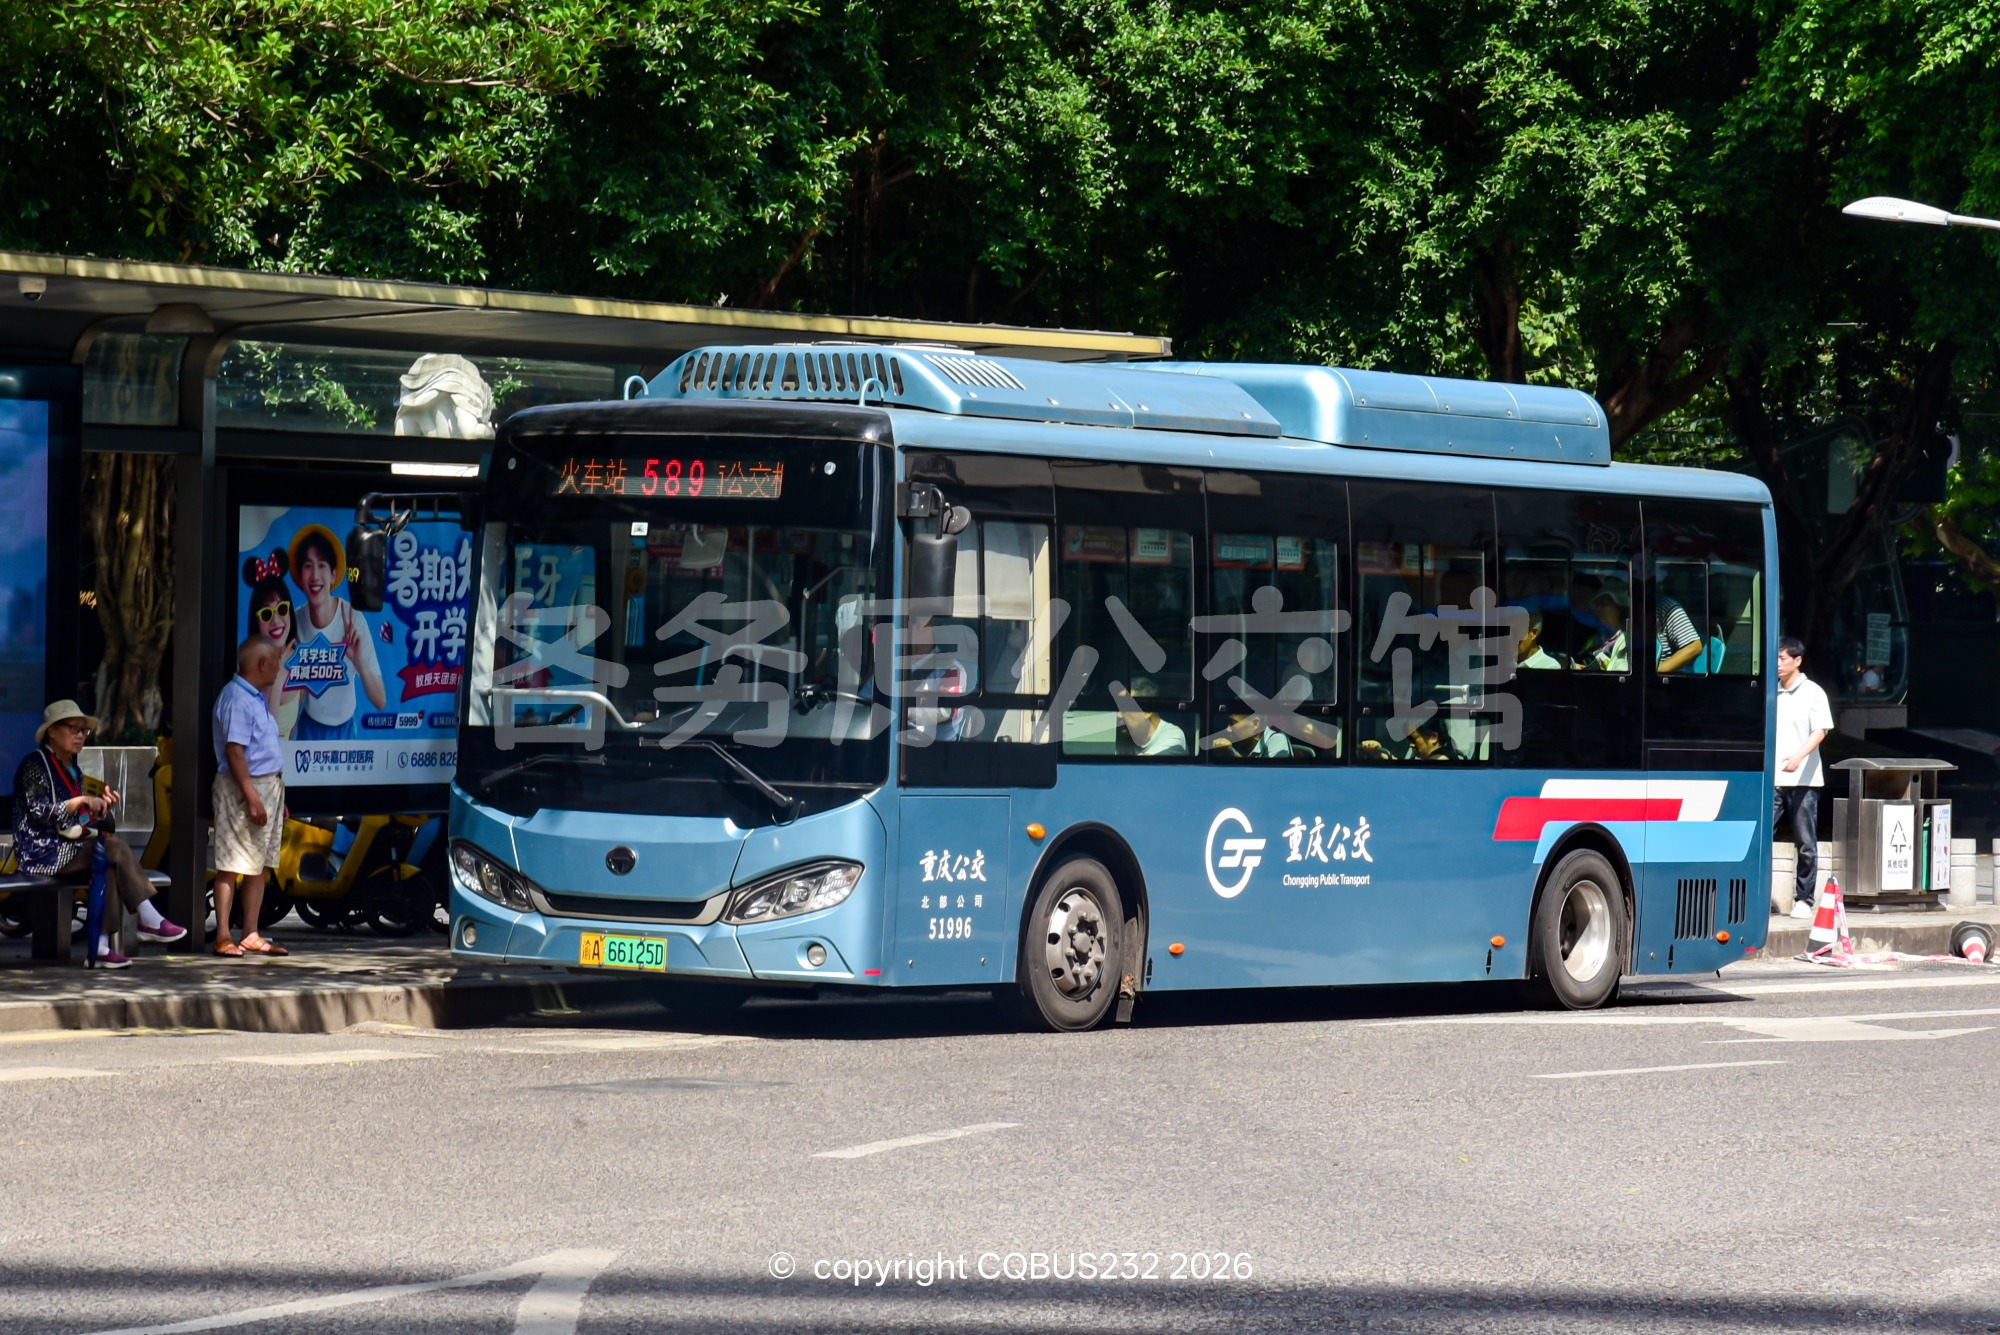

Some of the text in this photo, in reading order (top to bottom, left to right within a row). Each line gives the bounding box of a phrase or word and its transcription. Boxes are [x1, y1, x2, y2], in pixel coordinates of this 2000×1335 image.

[559, 458, 627, 495] 火车站
[642, 459, 705, 497] 589
[412, 606, 466, 661] 开学
[299, 648, 339, 665] 凭学生证
[290, 664, 344, 681] 再减500元
[399, 716, 418, 727] 5999
[411, 752, 437, 767] 6886
[1282, 816, 1373, 863] 重庆公交
[919, 849, 987, 883] 重庆公交
[1283, 874, 1371, 888] Chongqing Public Transport
[921, 895, 983, 909] 北部公司
[929, 917, 972, 940] 51996
